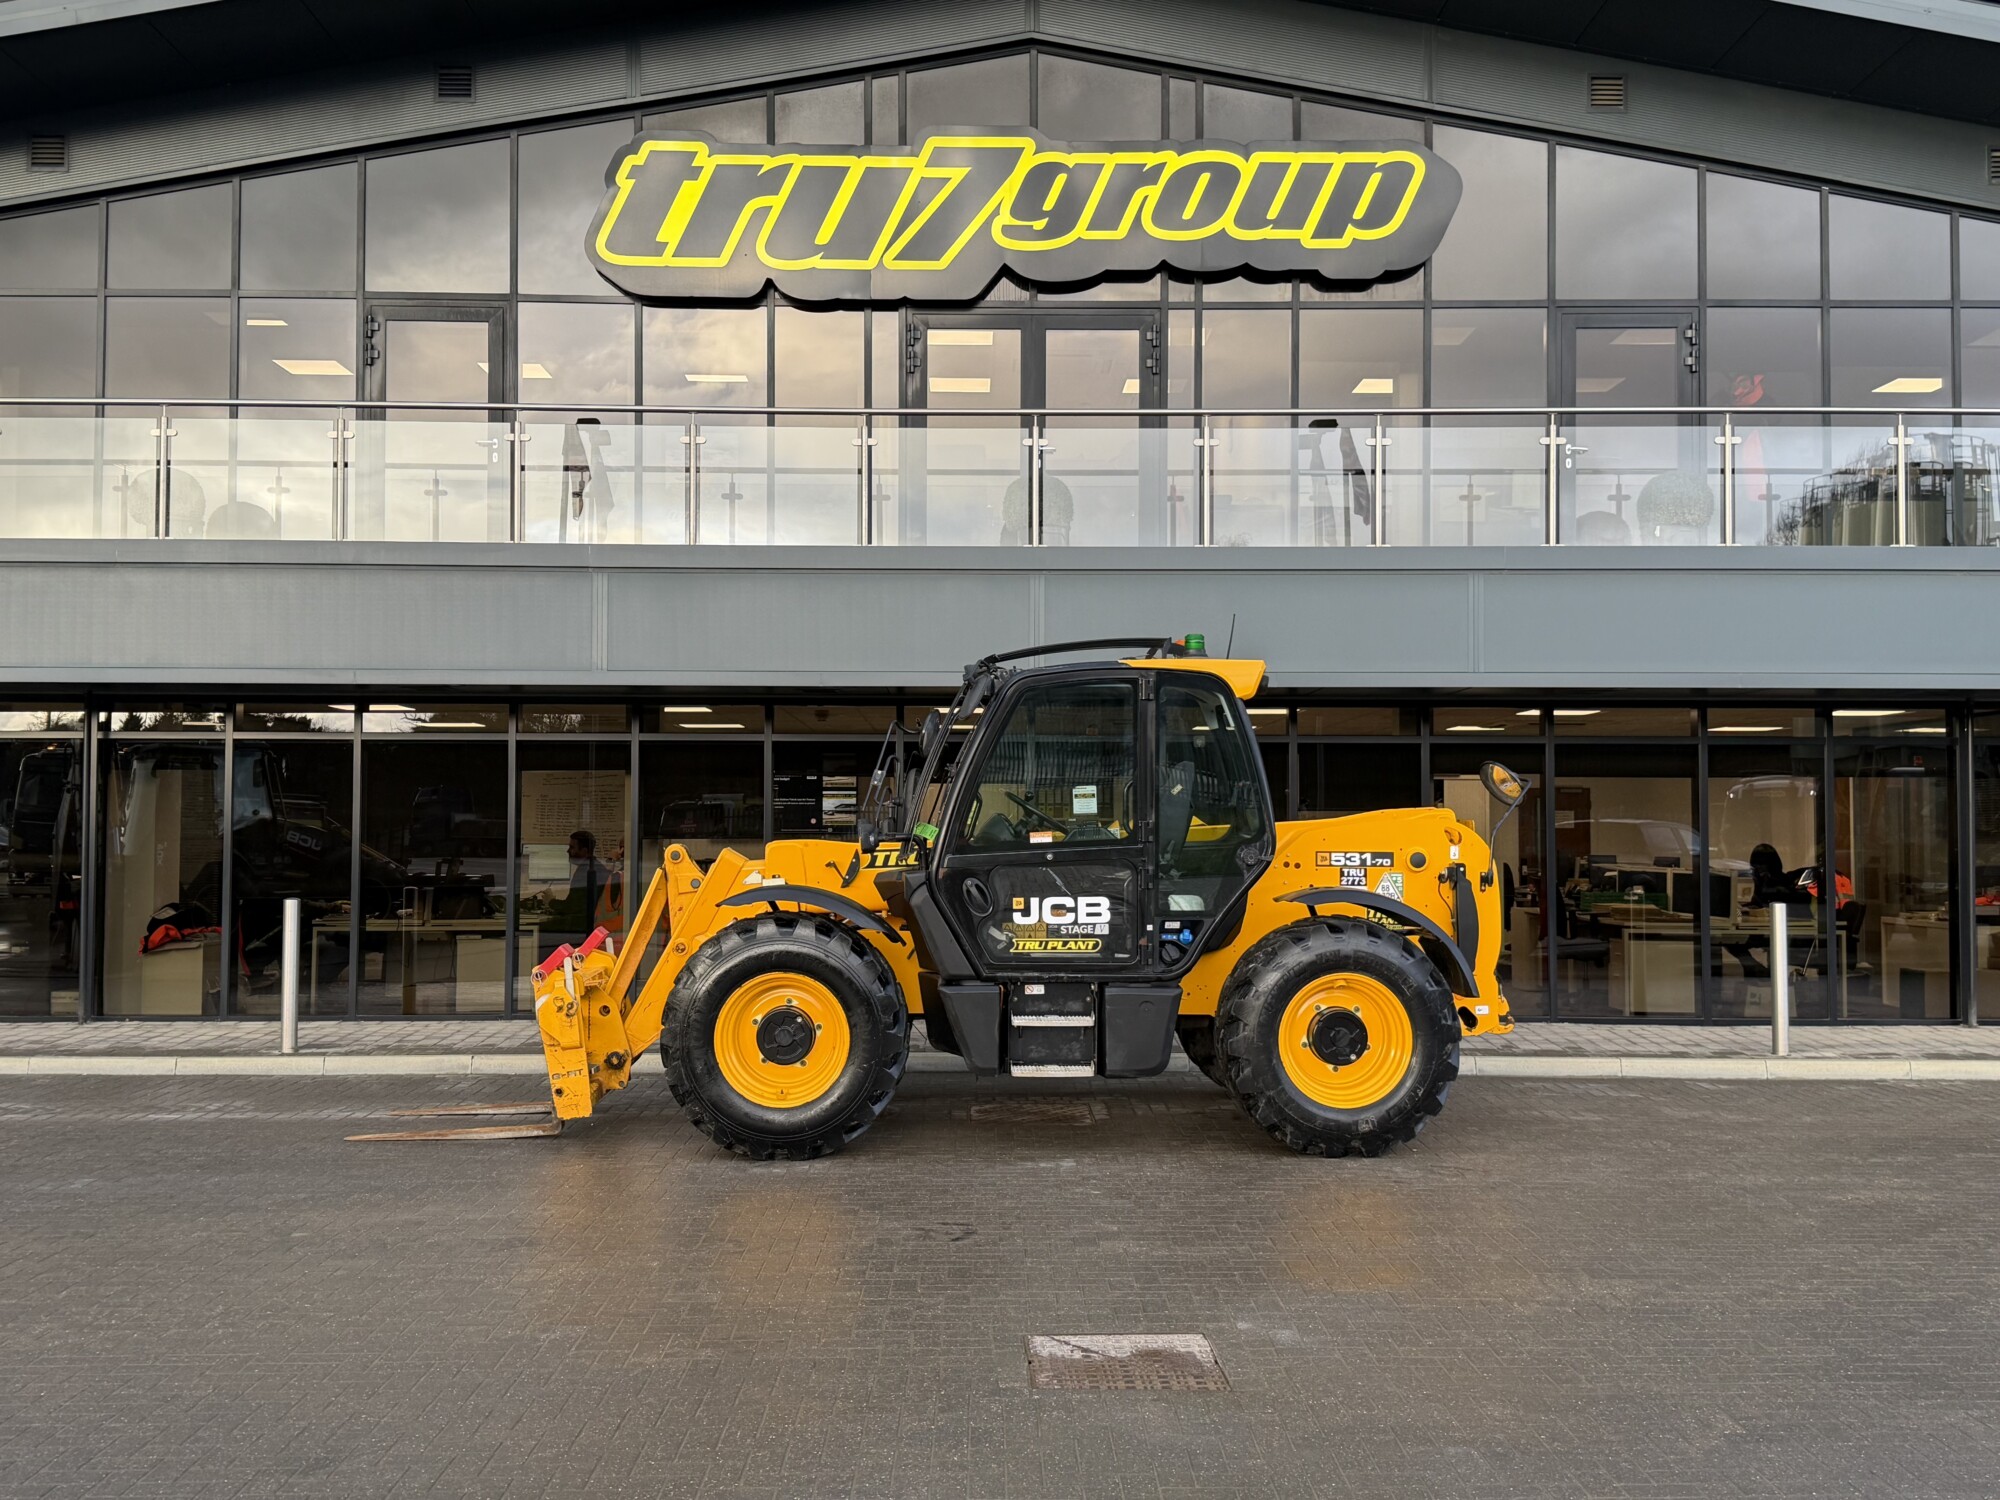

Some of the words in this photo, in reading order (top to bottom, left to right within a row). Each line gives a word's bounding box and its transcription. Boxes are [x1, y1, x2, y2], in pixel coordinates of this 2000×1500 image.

[1330, 852, 1391, 866] 531-70
[1341, 868, 1365, 876] TRU
[1340, 877, 1366, 885] 2773
[1012, 896, 1111, 924] JCB
[1060, 924, 1094, 935] STAGE
[1017, 941, 1046, 950] TRU
[1046, 941, 1097, 950] PLANT
